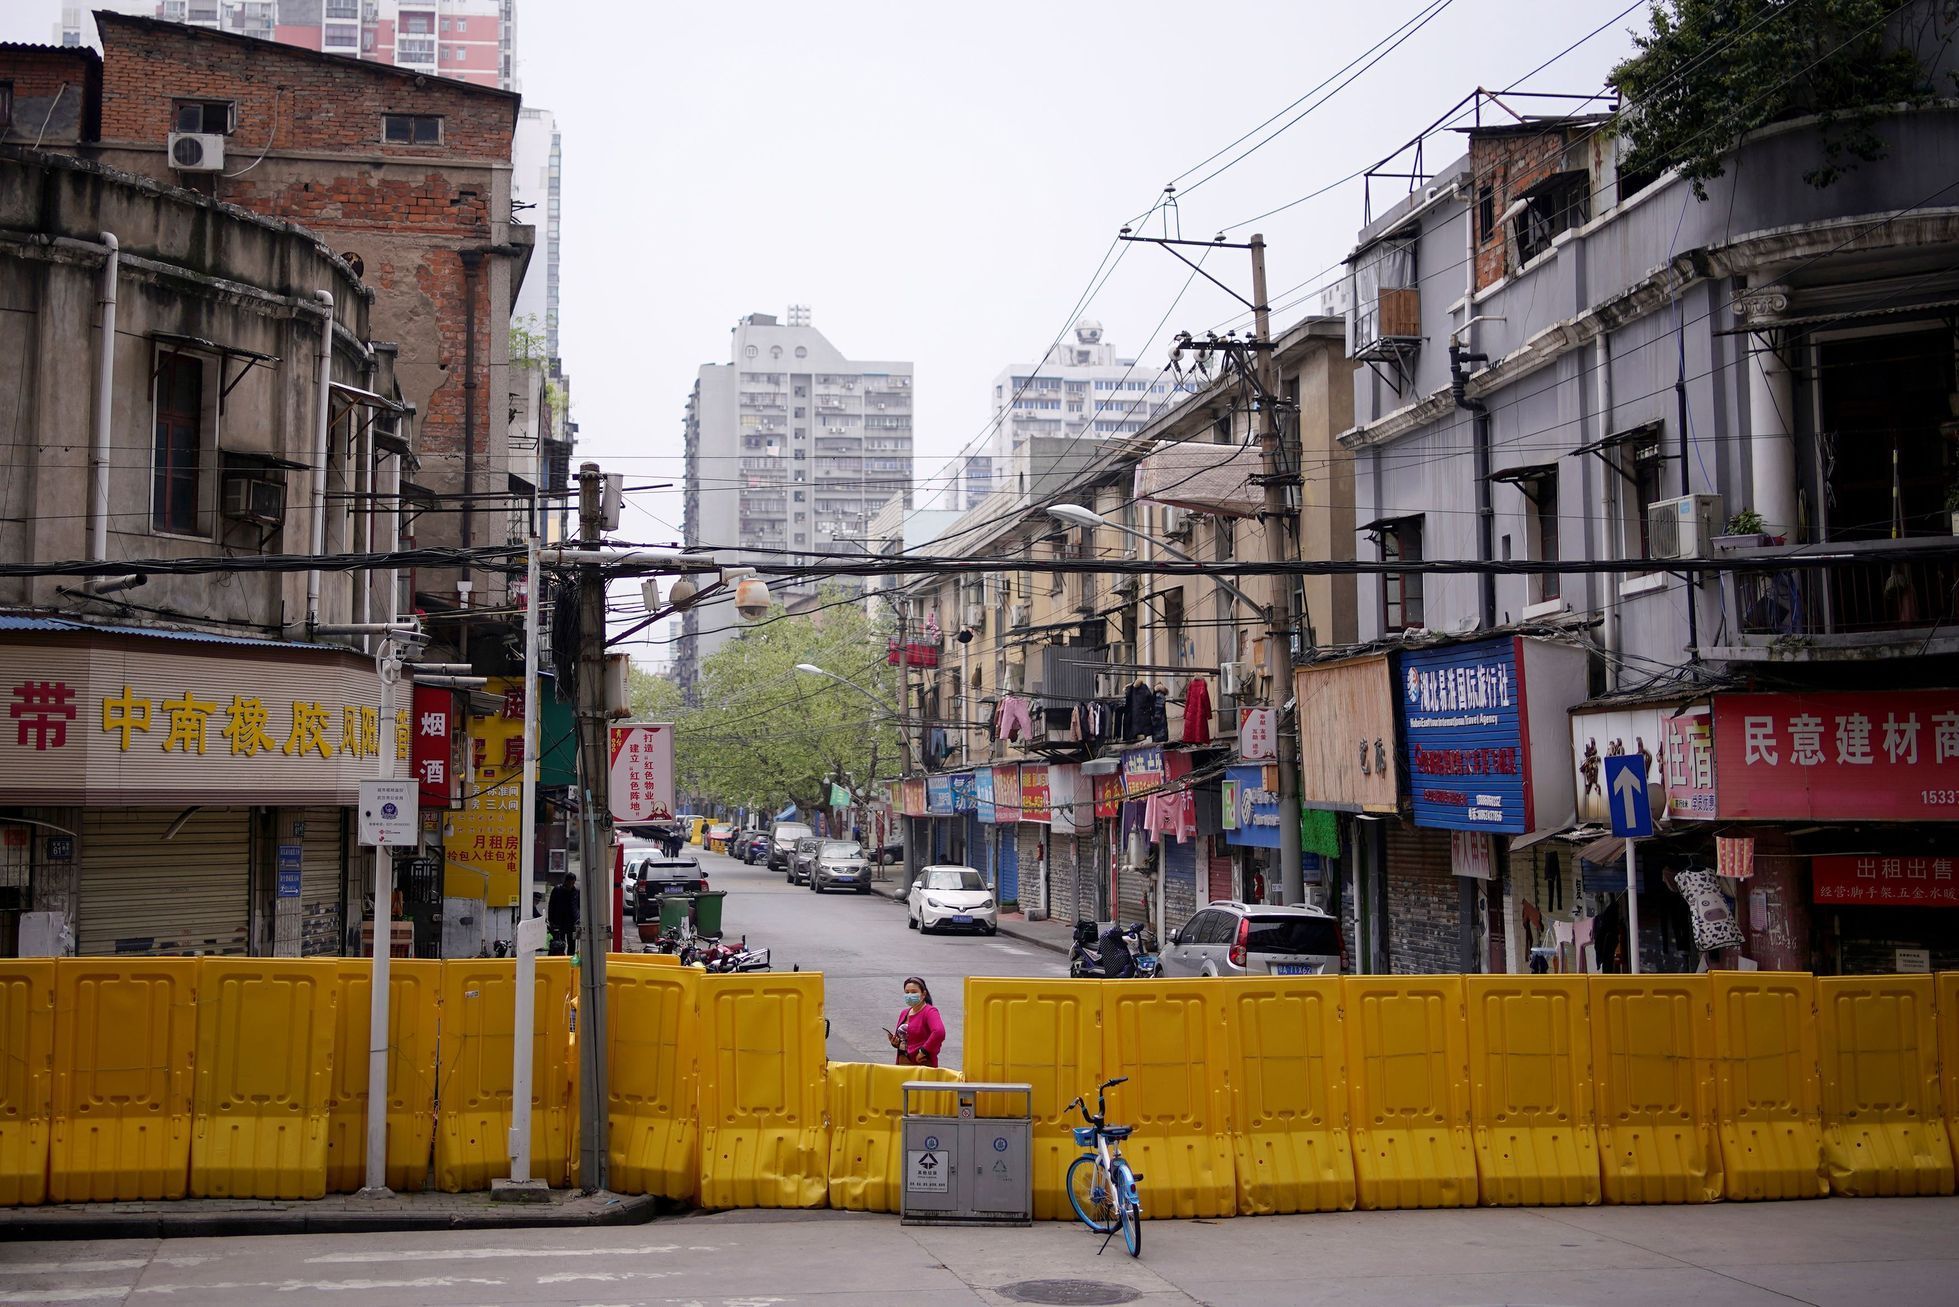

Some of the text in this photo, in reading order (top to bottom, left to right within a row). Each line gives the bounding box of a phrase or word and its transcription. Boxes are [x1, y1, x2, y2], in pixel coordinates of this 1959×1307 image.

[10, 681, 76, 751] 带
[1480, 713, 1498, 726] Agency
[1744, 711, 1959, 767] 民意建材商
[420, 712, 447, 785] 烟酒
[1664, 719, 1714, 789] 住宿
[486, 785, 519, 797] 标准间
[486, 800, 519, 810] 三人间
[473, 835, 519, 850] 月租房
[447, 851, 517, 861] 拎包入住包水
[507, 861, 517, 872] 电
[1857, 858, 1953, 880] 出租出售
